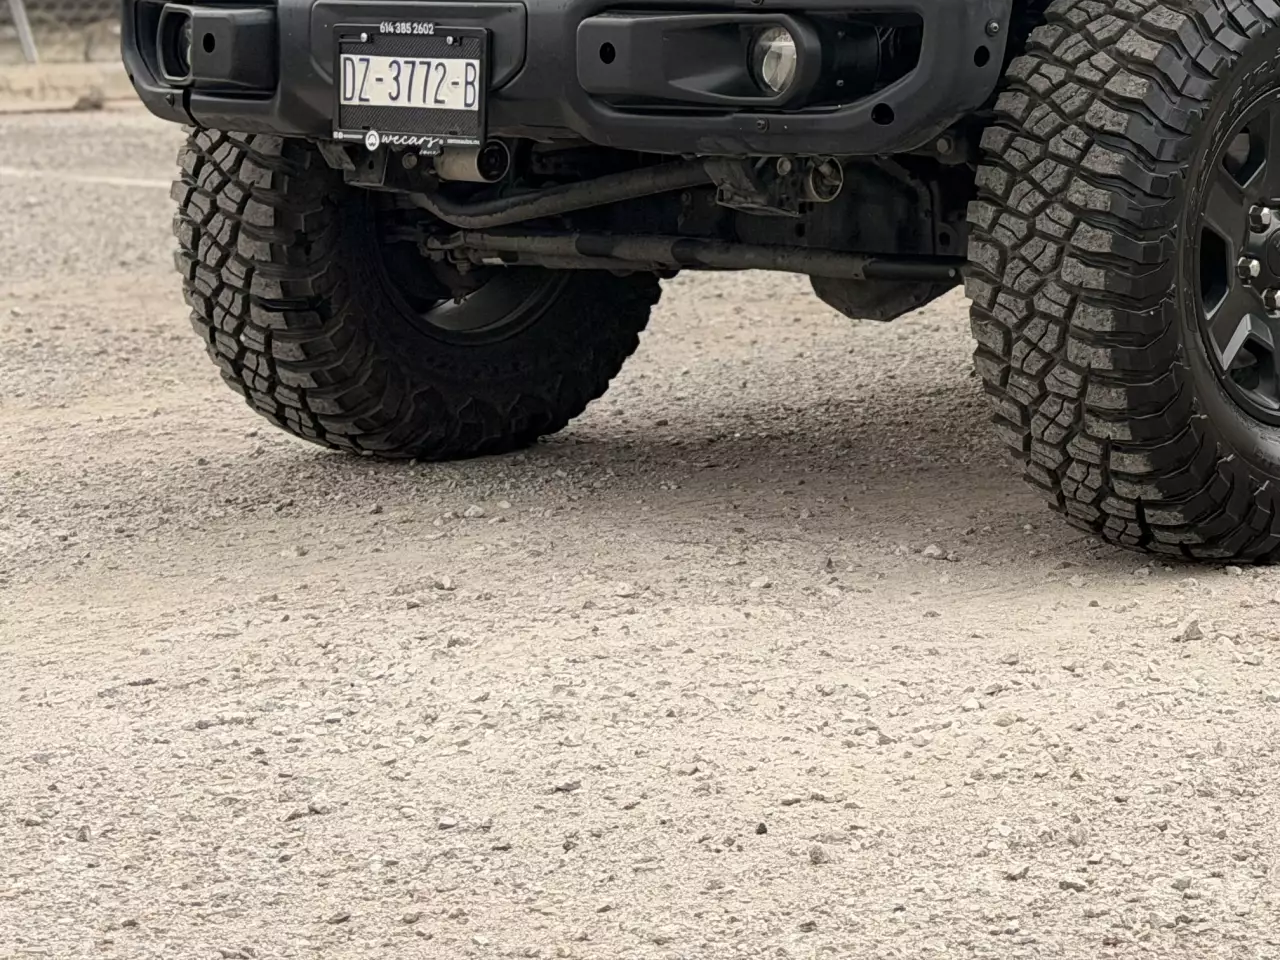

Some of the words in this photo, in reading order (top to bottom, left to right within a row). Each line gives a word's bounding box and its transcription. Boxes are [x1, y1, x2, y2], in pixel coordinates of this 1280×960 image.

[380, 21, 394, 34] 614
[395, 22, 412, 34] 385
[412, 23, 434, 35] 2602
[342, 56, 477, 108] DZ-3772-B
